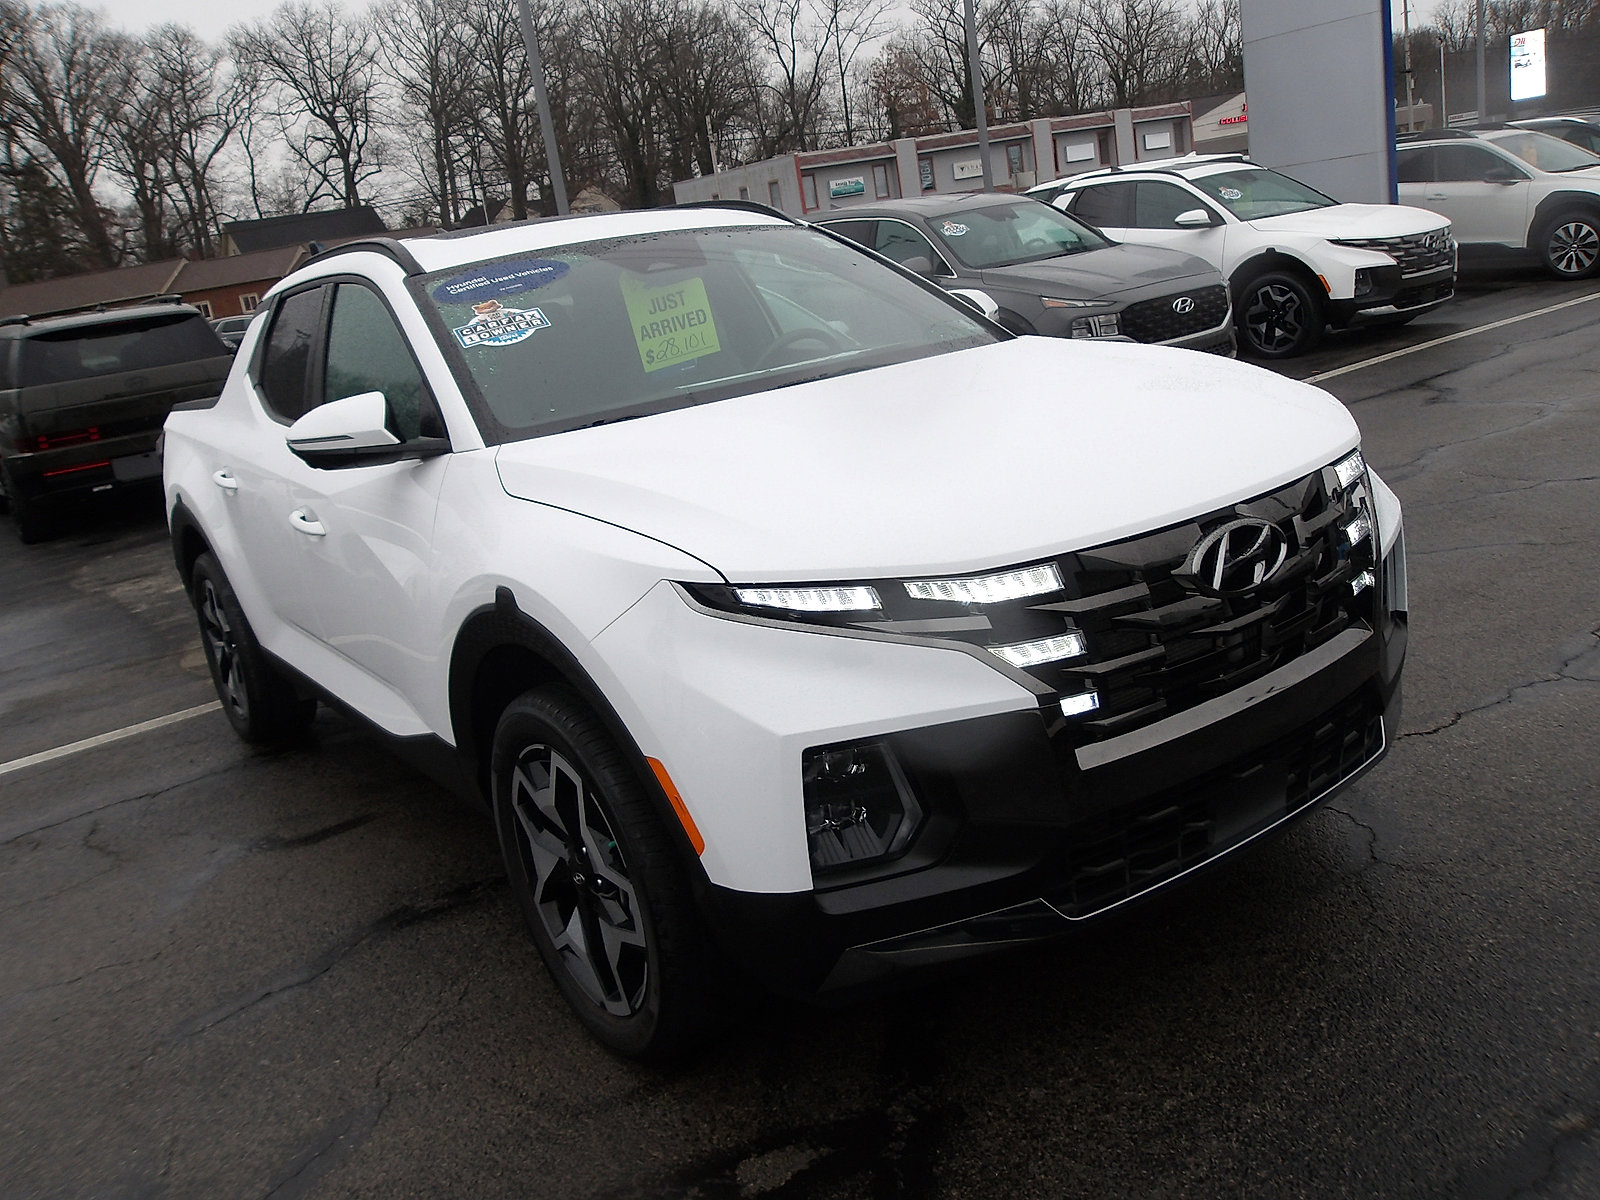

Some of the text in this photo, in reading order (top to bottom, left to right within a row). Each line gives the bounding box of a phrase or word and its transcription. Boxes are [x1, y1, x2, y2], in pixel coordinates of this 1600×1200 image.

[920, 159, 934, 188] YOGA
[445, 276, 487, 291] Hyundai
[450, 279, 491, 295] Certified
[491, 273, 515, 283] Used
[514, 266, 554, 277] Vehicles
[648, 290, 686, 315] JUST
[461, 313, 537, 335] CARFAX
[479, 320, 544, 340] OWNER
[640, 309, 707, 342] ARRIVED
